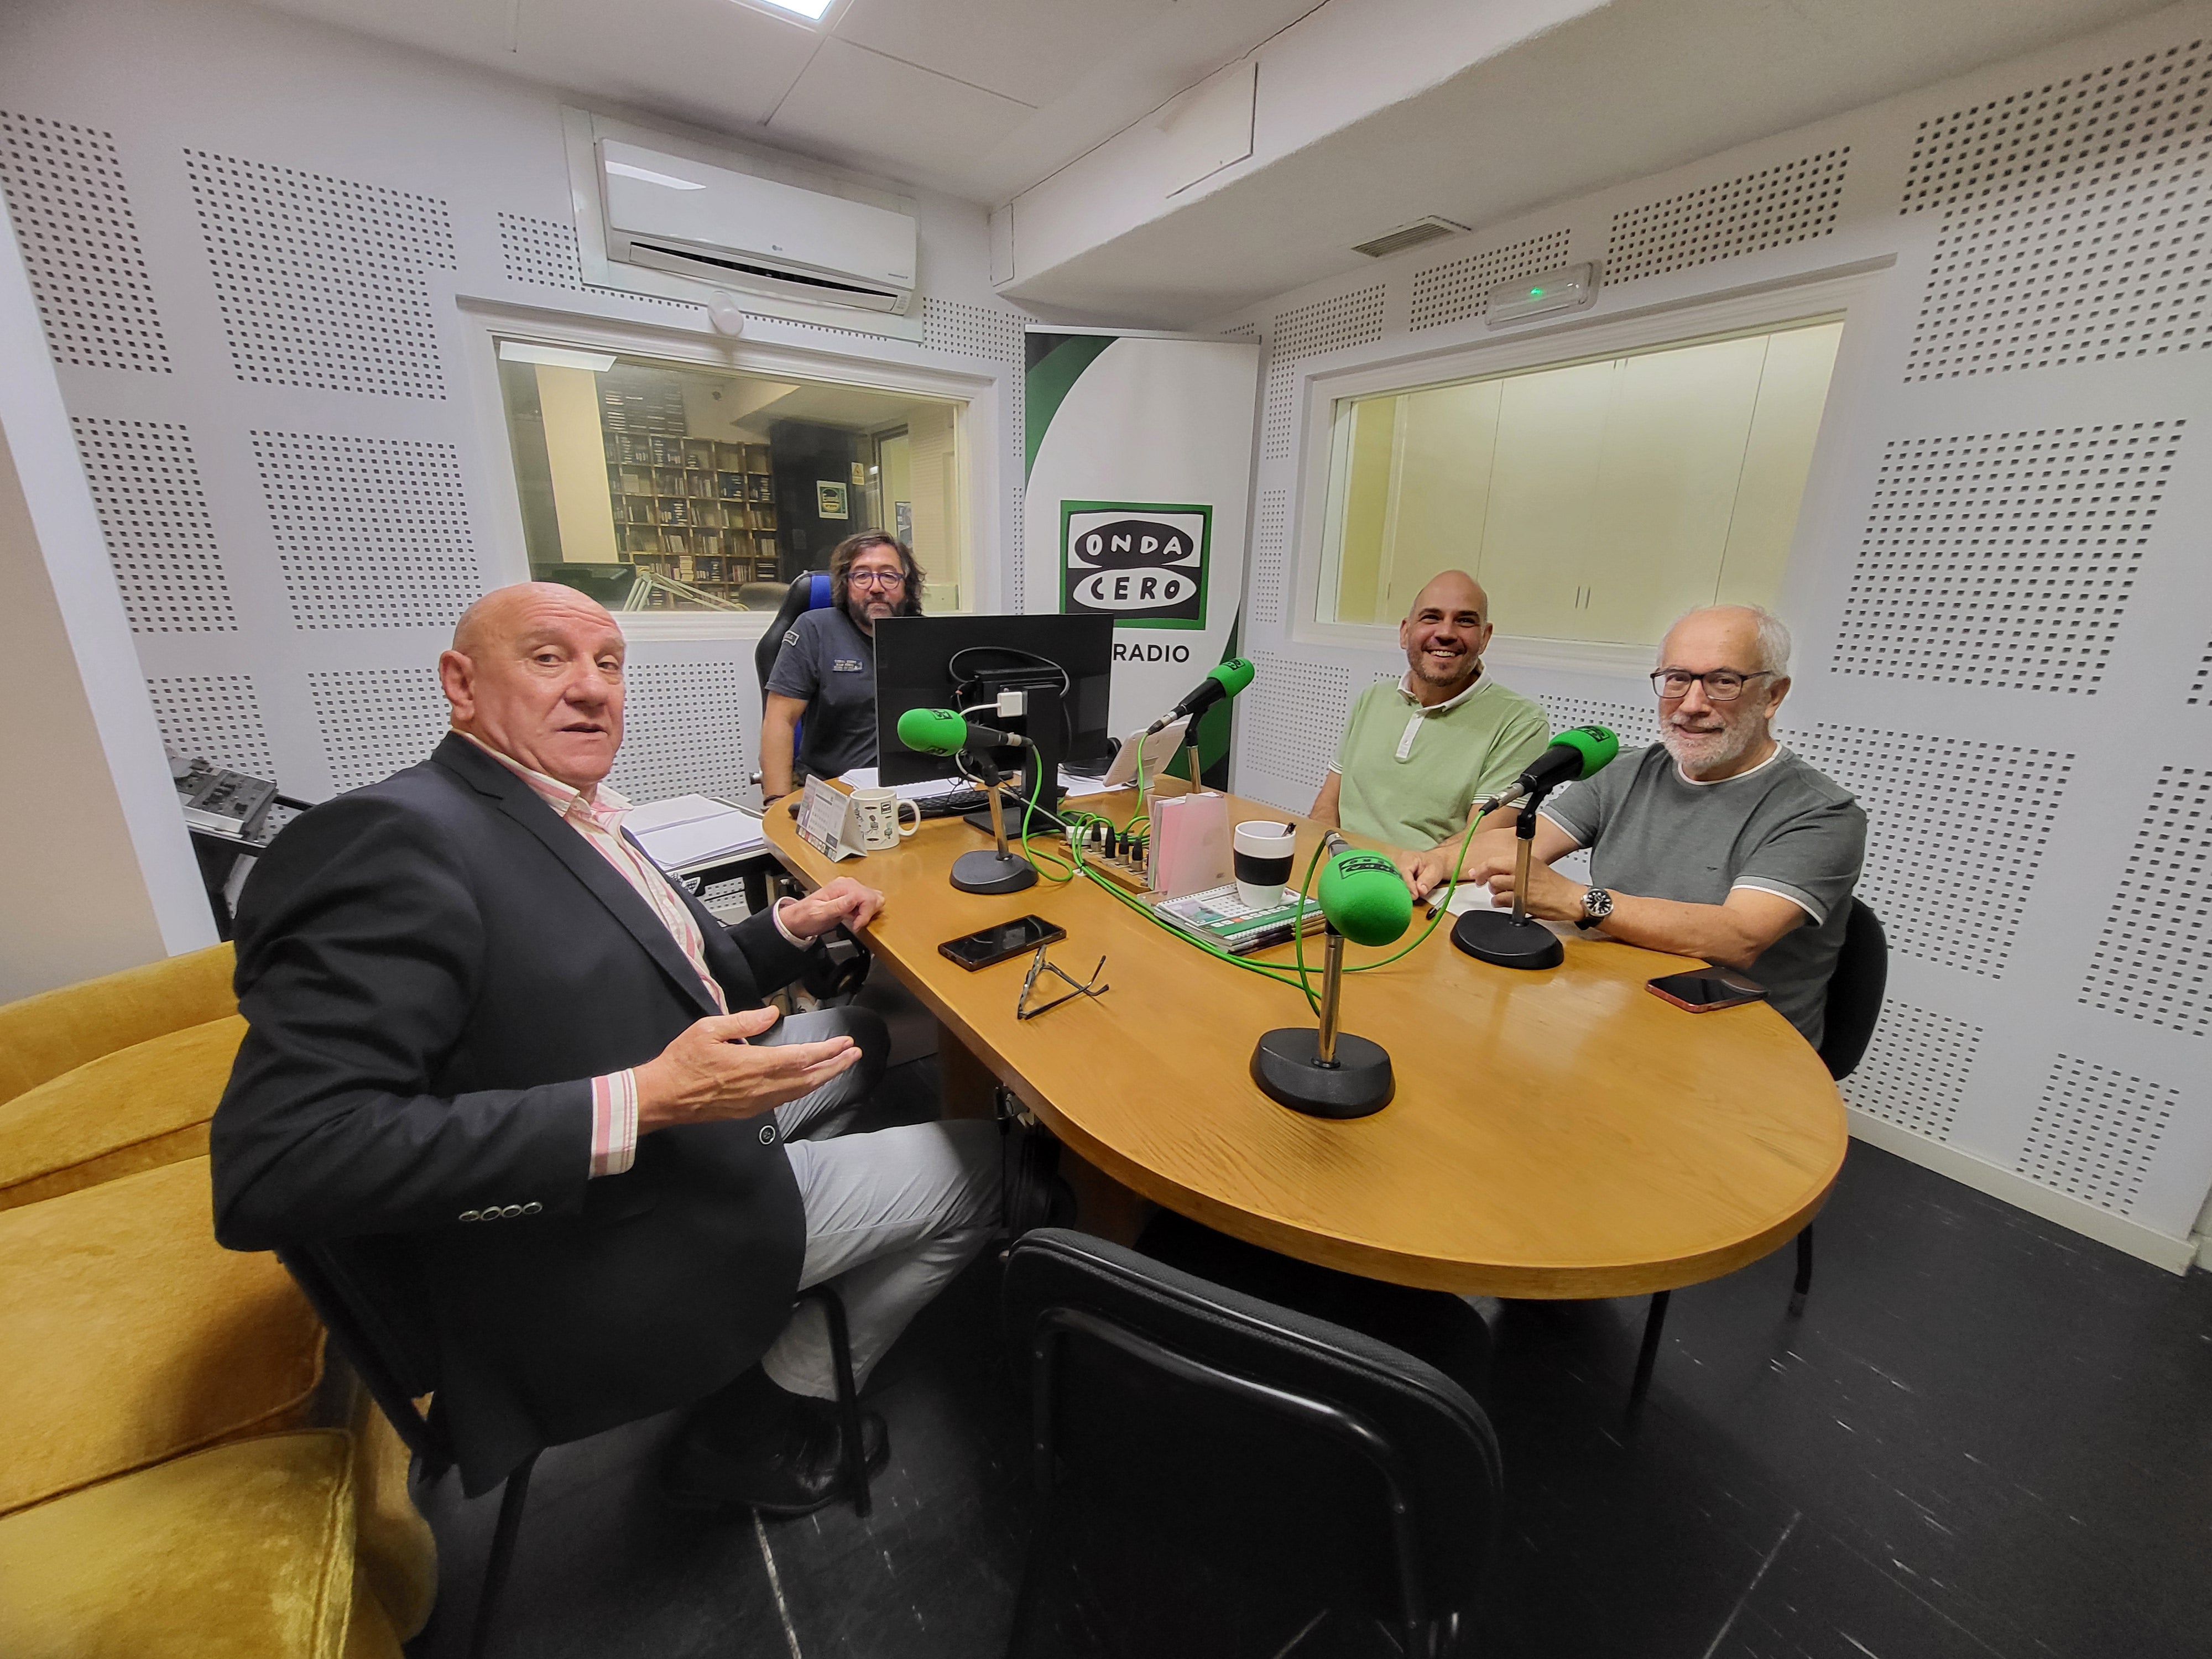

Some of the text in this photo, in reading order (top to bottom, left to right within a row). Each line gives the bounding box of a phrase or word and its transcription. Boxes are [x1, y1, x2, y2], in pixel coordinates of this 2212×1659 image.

[1086, 534, 1182, 556] ONDA
[1091, 576, 1180, 601] CERO
[1113, 643, 1190, 663] RADIO
